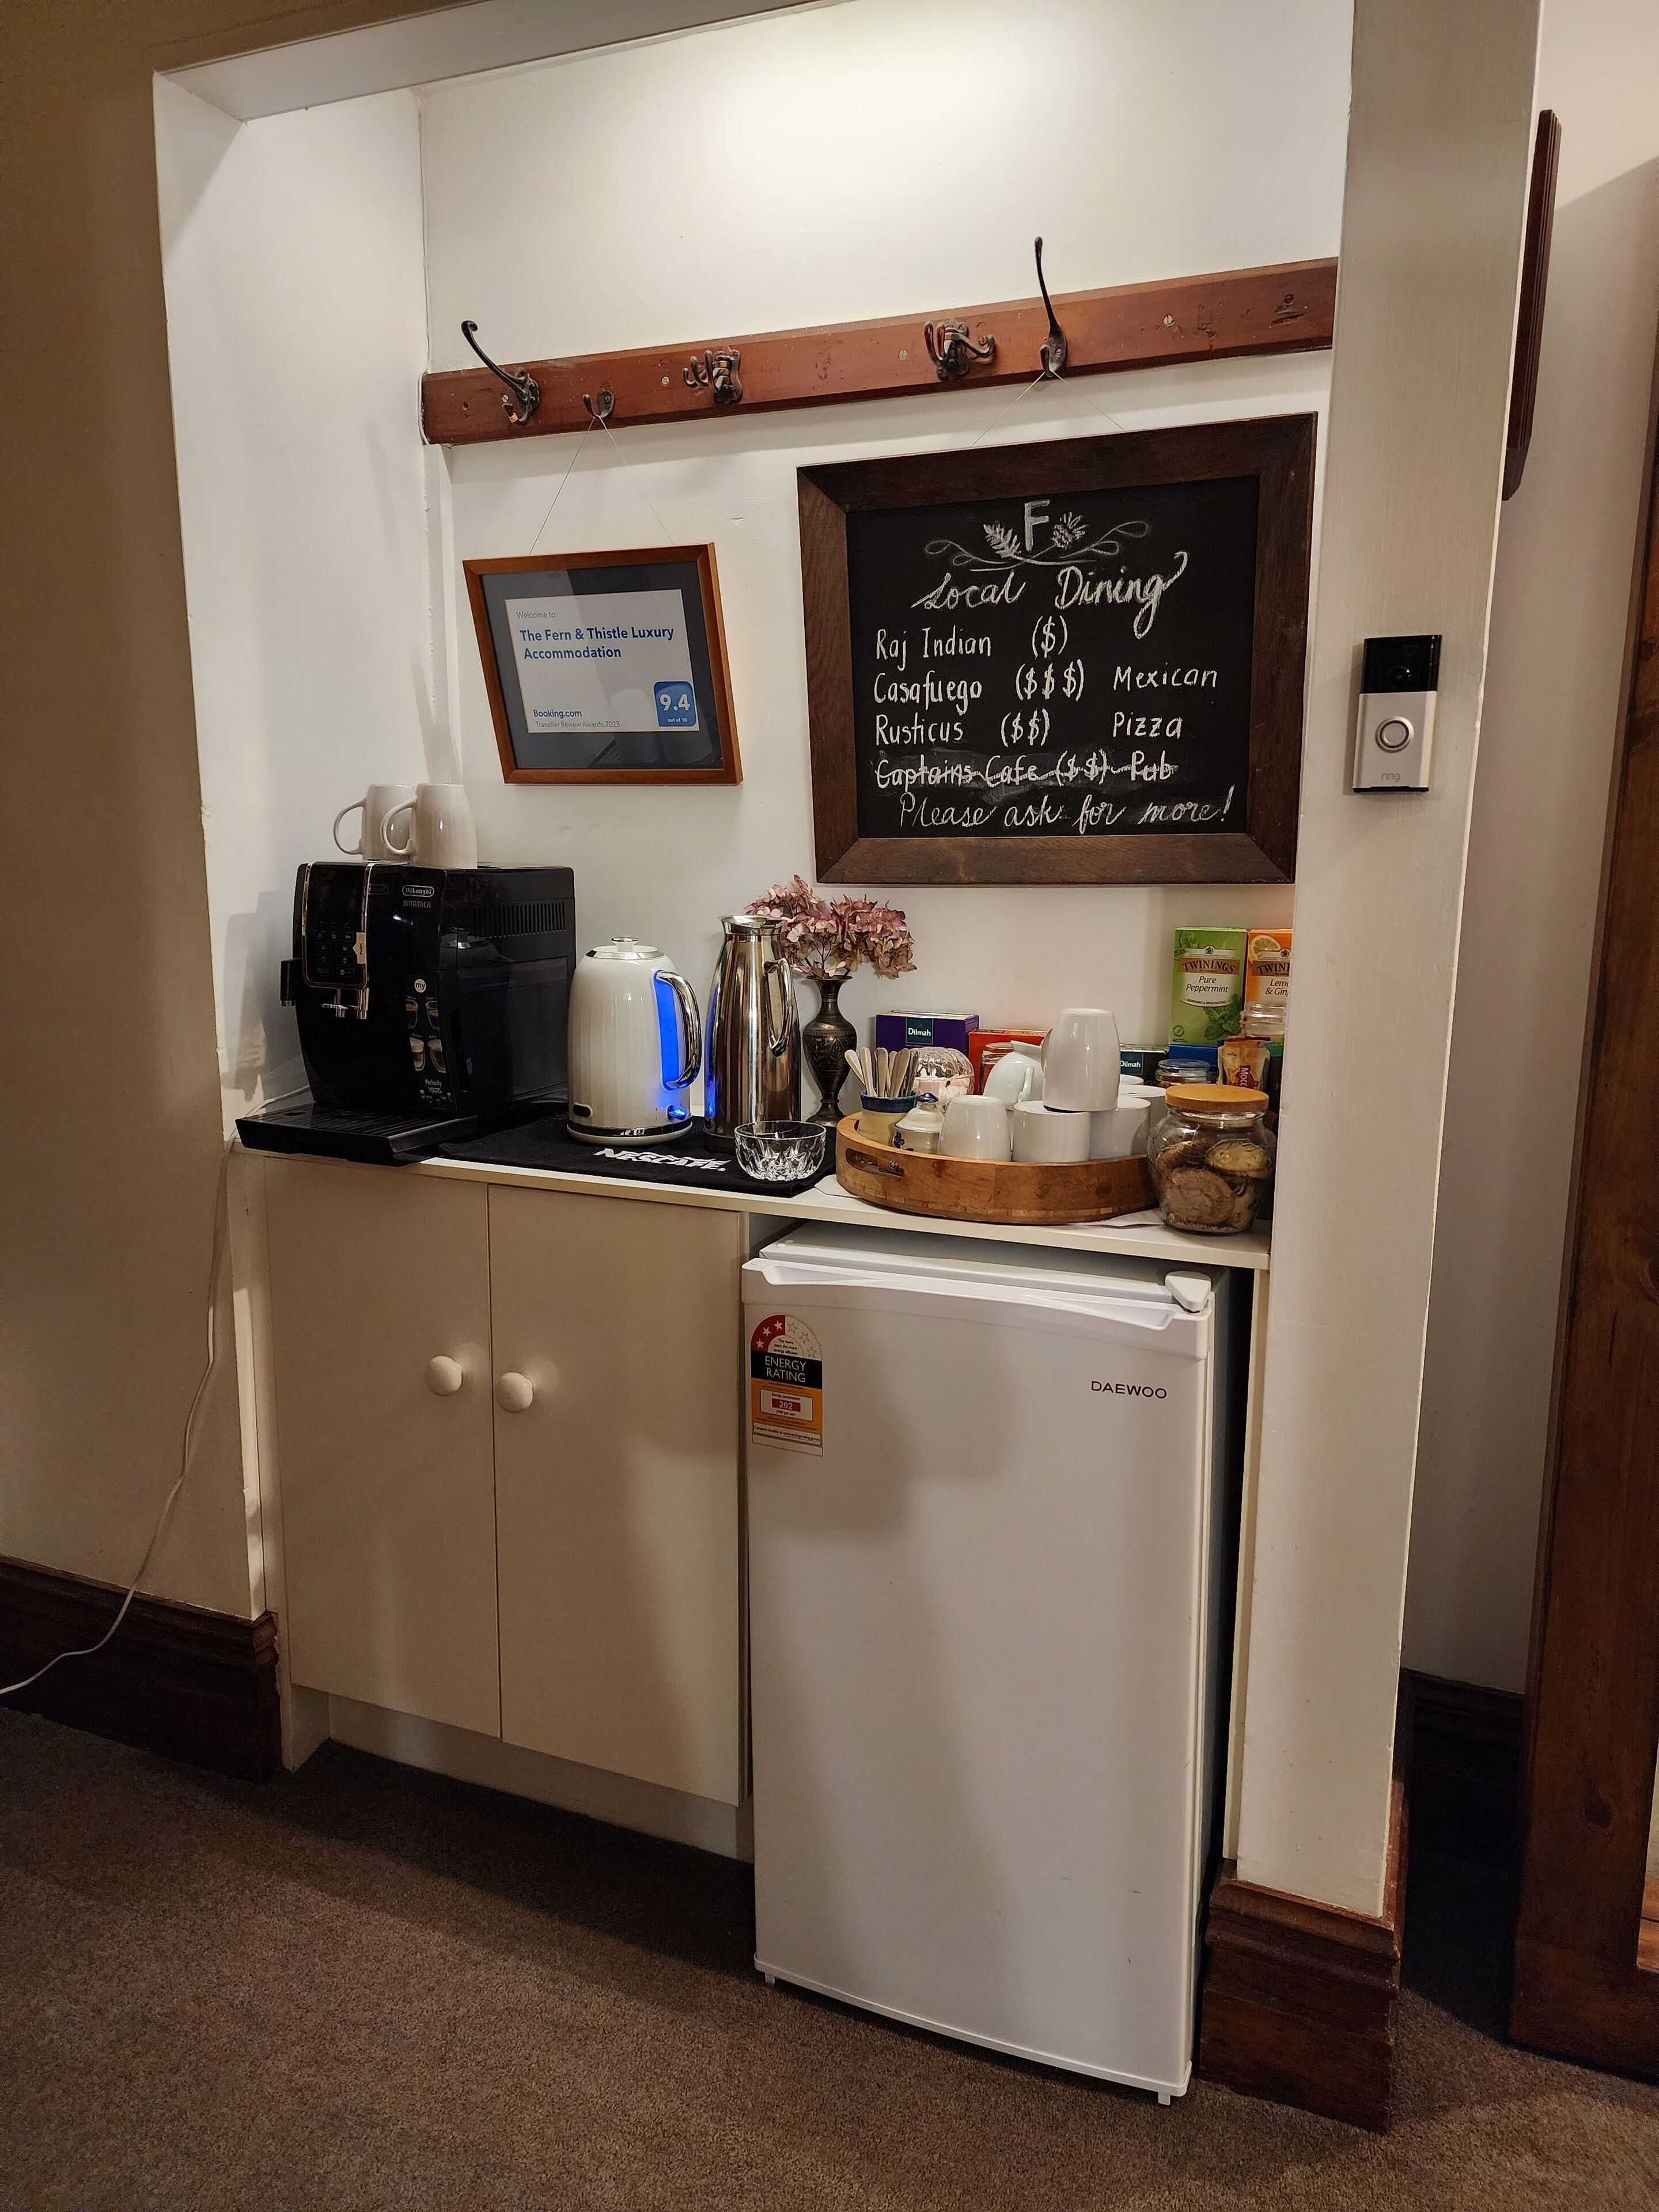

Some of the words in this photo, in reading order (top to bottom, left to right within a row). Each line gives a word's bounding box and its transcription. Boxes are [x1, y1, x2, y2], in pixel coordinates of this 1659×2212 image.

[1023, 499, 1051, 552] F
[910, 569, 1026, 609] Local
[1055, 551, 1188, 640] Dining
[520, 629, 542, 641] The
[545, 629, 571, 641] Fern
[575, 628, 585, 640] &
[586, 626, 628, 639] Thistle
[631, 626, 674, 641] Luxury
[876, 628, 908, 671] Raj
[922, 625, 991, 658] Indian
[1032, 615, 1068, 658] ($)
[524, 646, 622, 660] Accommodation
[873, 670, 983, 715] Casafuego
[1113, 662, 1218, 691] Mexican
[660, 694, 690, 711] 9.4
[533, 709, 582, 719] Booking.com
[876, 711, 964, 746] Rusticus
[1113, 711, 1183, 738] Pizza
[1381, 772, 1400, 782] ring
[900, 792, 995, 828] Please
[1004, 795, 1060, 828] ask
[1073, 794, 1126, 835] for
[1137, 785, 1236, 826] more!
[403, 900, 431, 908] DINAMICA
[1182, 959, 1236, 973] TWININGS
[1256, 962, 1290, 975] TWINI
[1198, 976, 1217, 984] Pure
[1185, 983, 1229, 994] Peppermint
[908, 1028, 931, 1036] Dilmah
[765, 1355, 806, 1371] ENERGY
[767, 1367, 806, 1382] RATING
[1091, 1381, 1167, 1399] DAEWOO
[779, 1400, 793, 1410] 202
